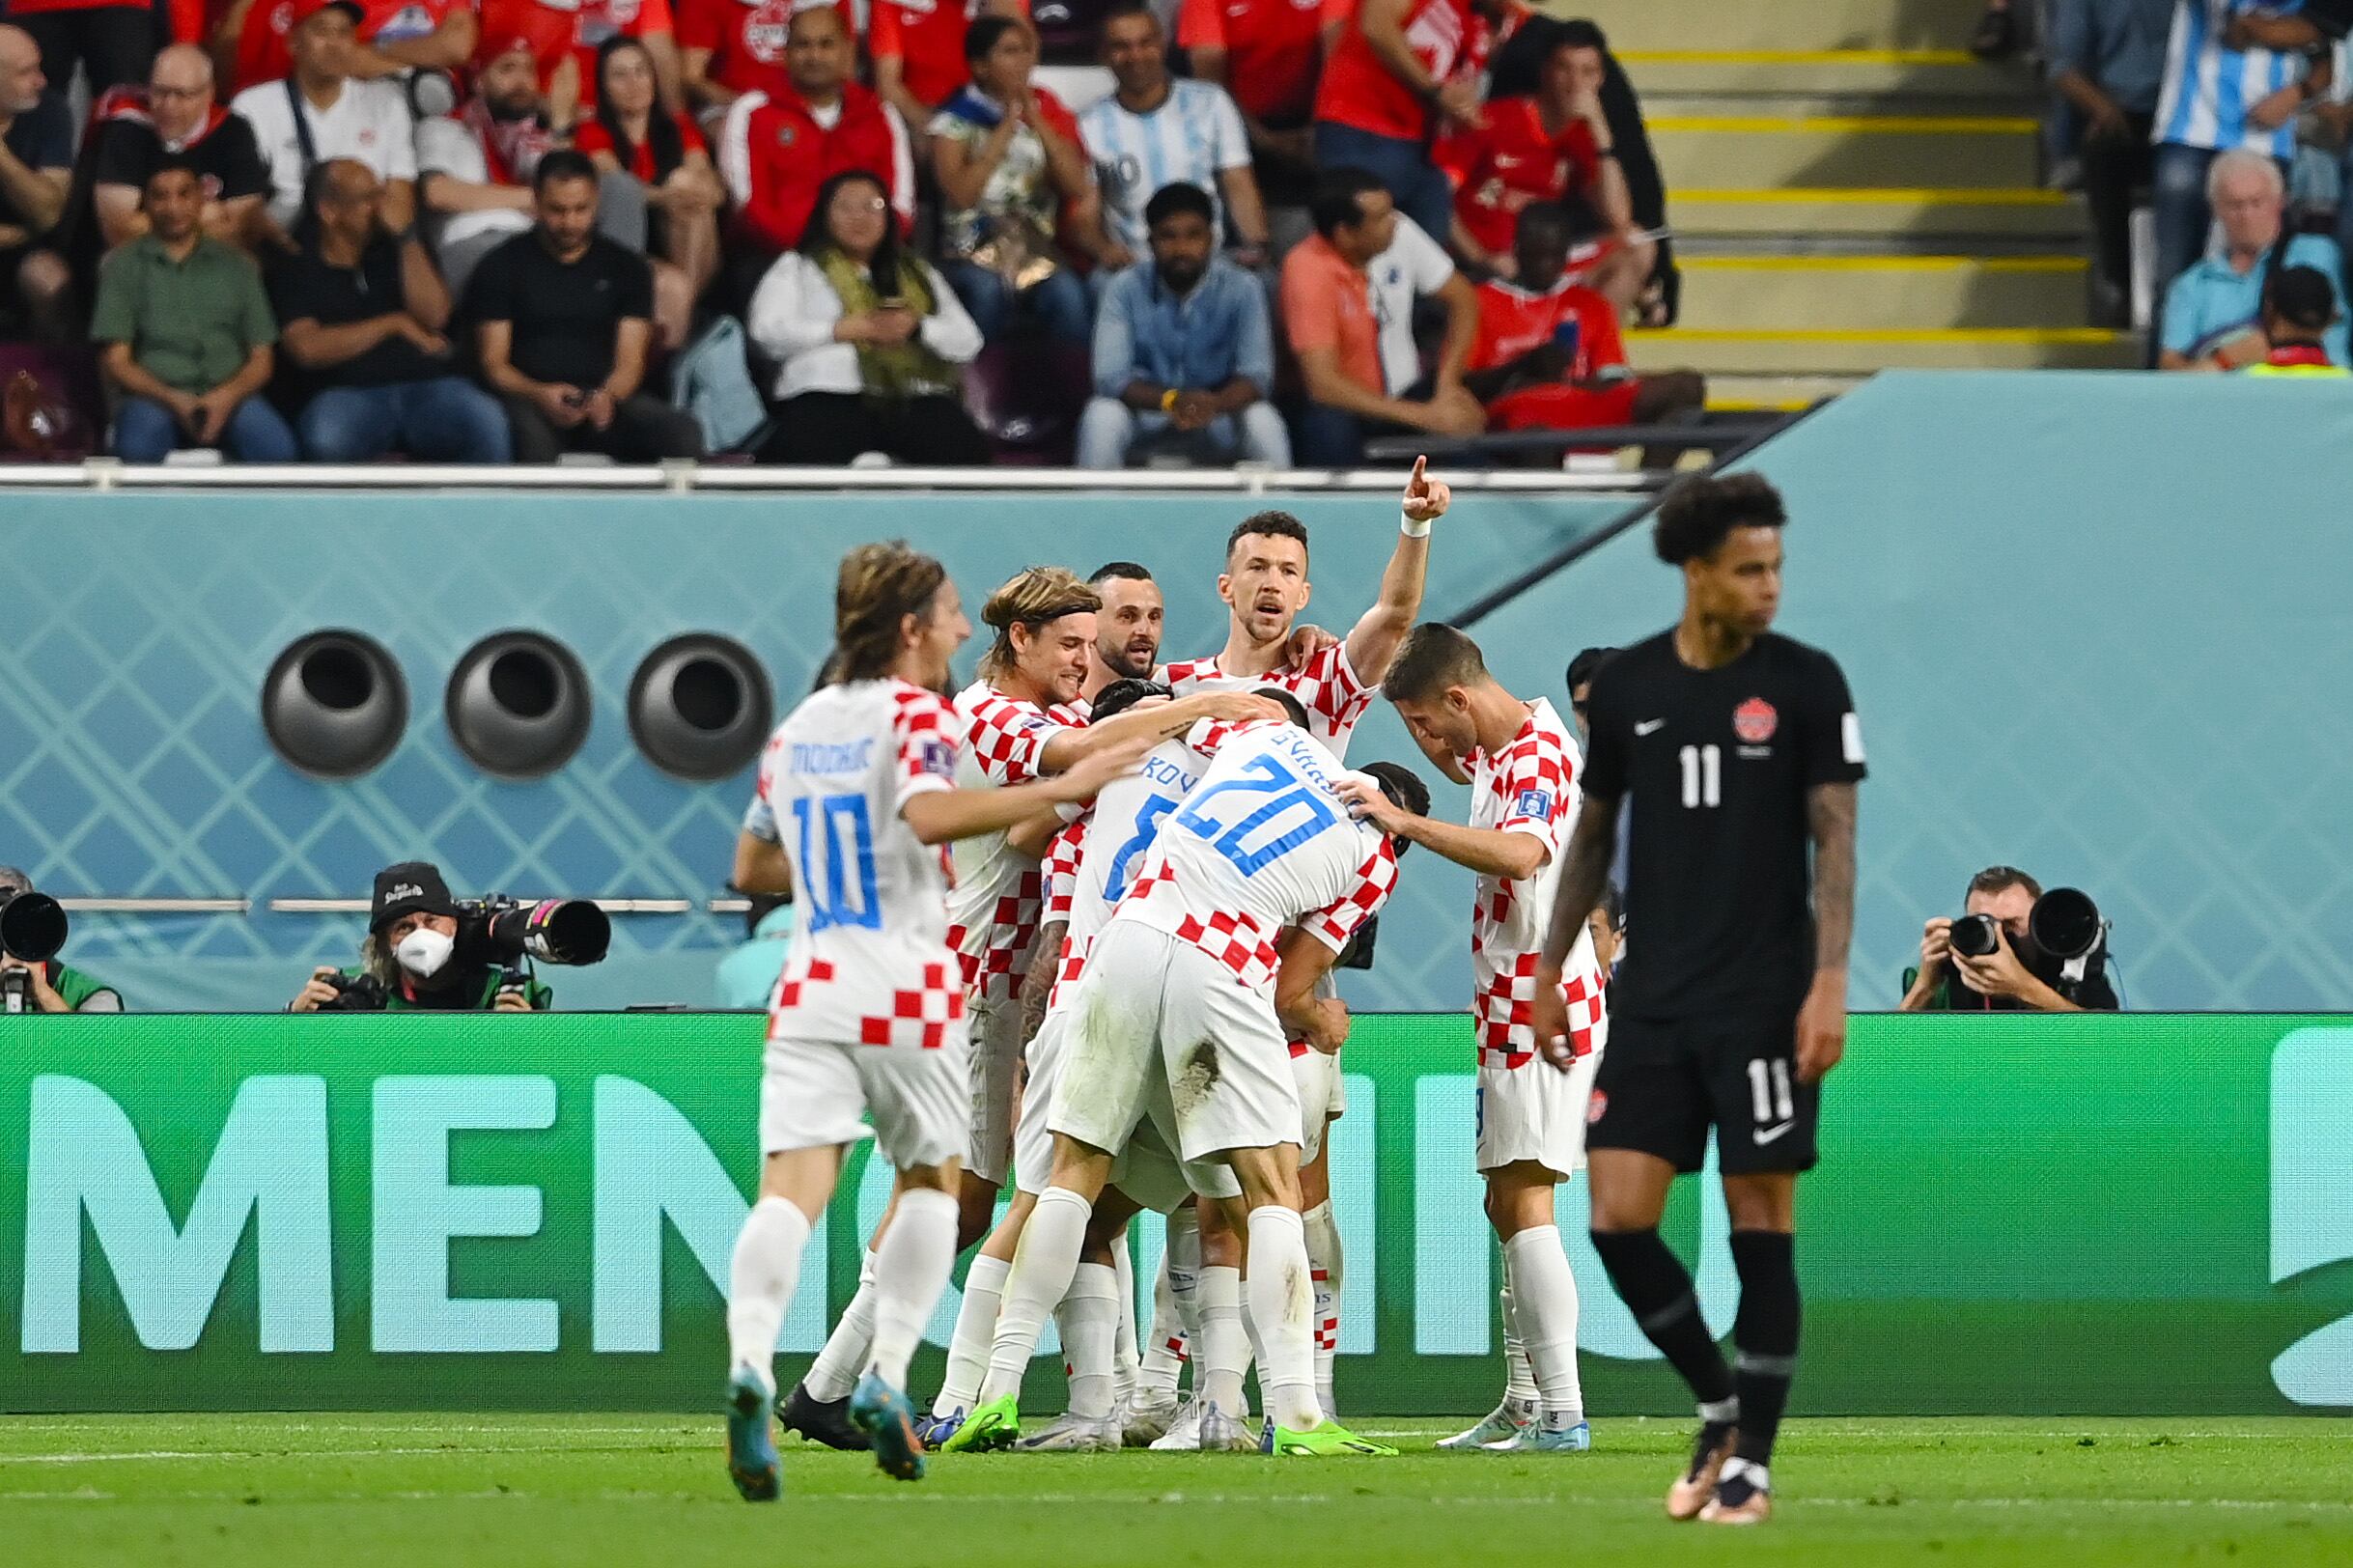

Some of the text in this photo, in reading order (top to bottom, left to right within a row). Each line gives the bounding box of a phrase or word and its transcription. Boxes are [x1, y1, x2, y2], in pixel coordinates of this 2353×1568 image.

[1142, 756, 1199, 795] KOV
[1679, 743, 1722, 809] 11
[1175, 752, 1338, 878] 20
[792, 793, 882, 933] 10
[1747, 1057, 1794, 1122] 11
